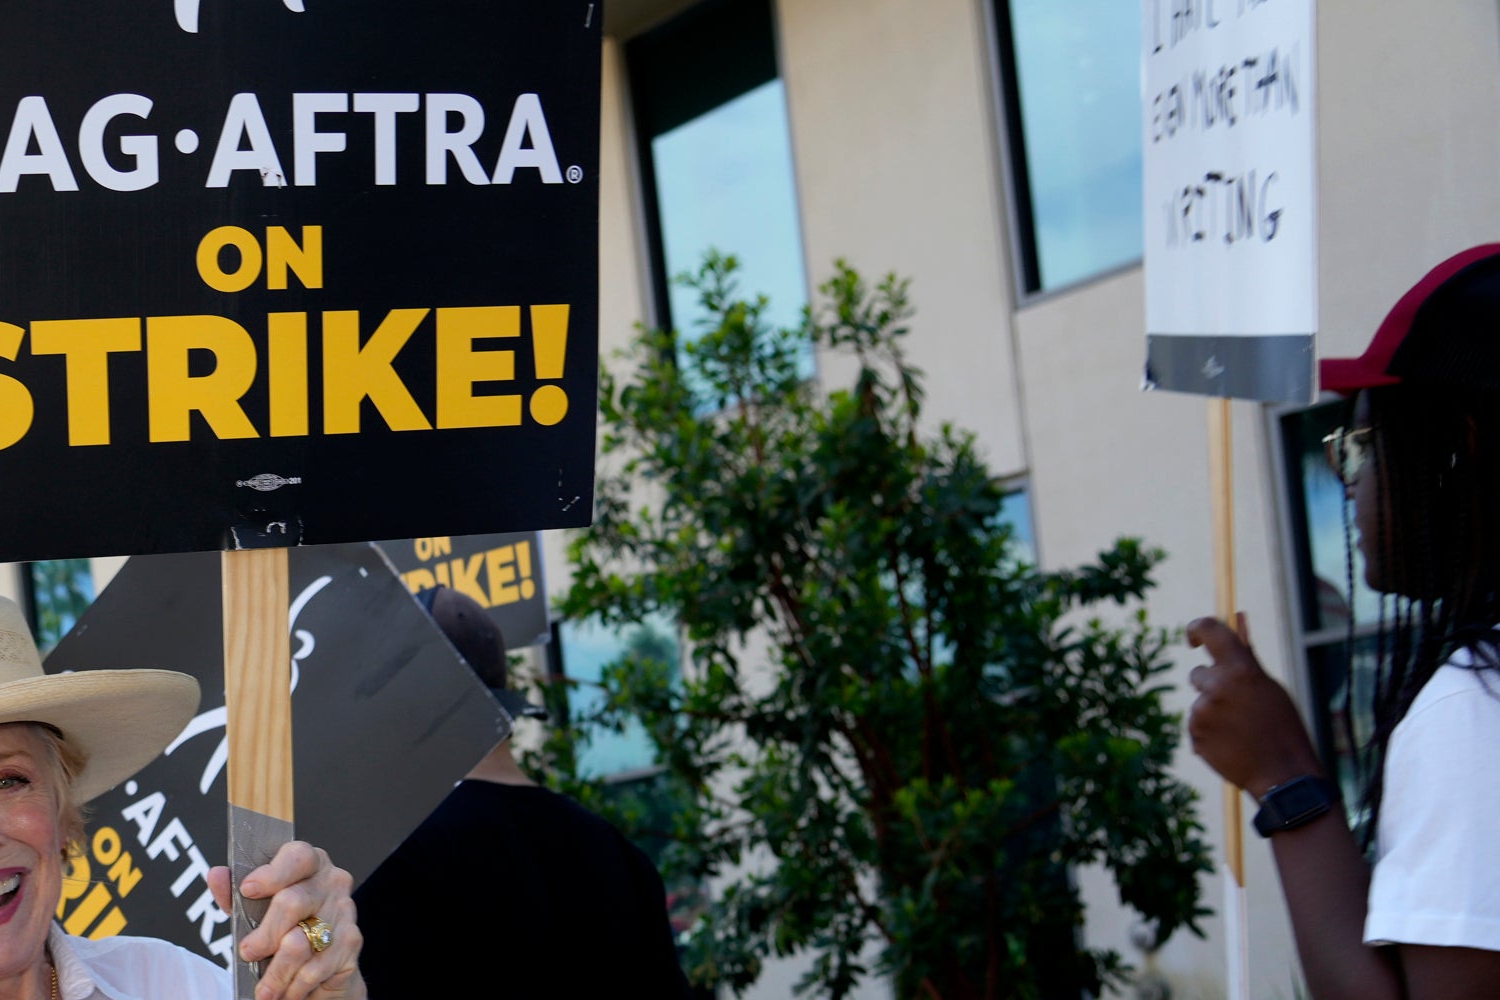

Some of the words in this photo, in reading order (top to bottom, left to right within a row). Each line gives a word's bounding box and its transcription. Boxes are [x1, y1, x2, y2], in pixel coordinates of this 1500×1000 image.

[196, 225, 323, 293] ON
[414, 536, 452, 562] ON
[92, 826, 144, 898] ON
